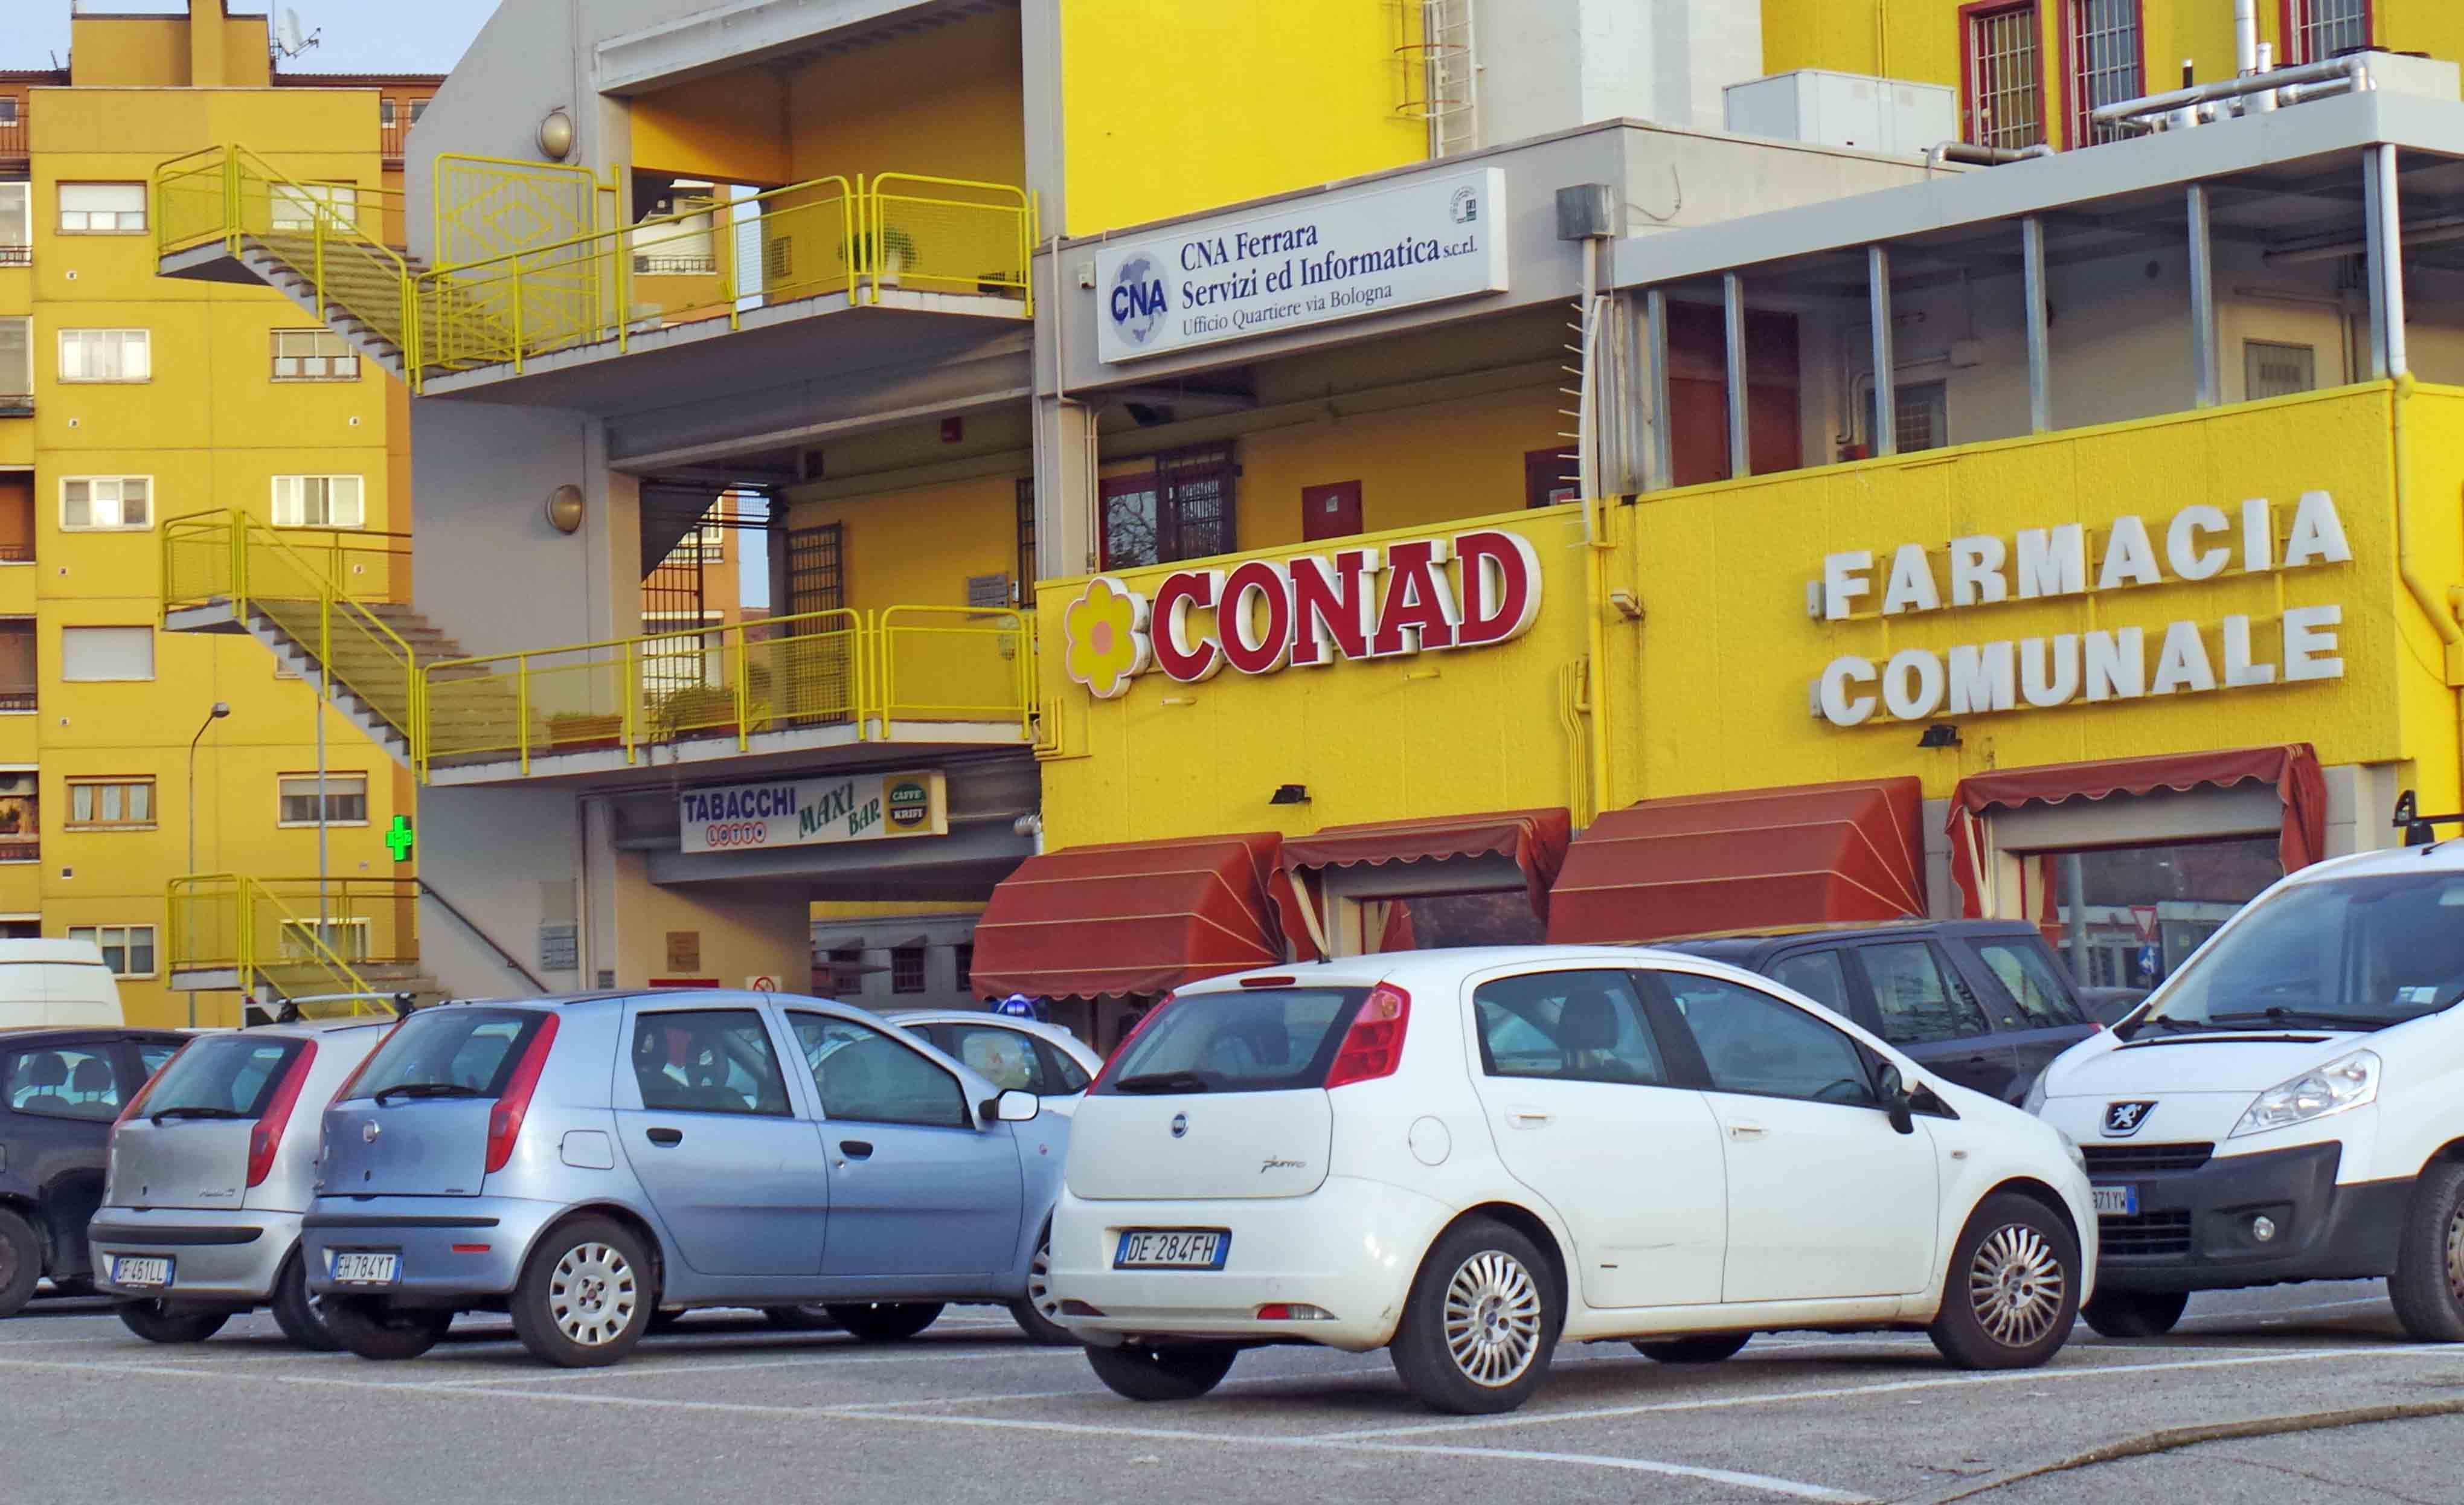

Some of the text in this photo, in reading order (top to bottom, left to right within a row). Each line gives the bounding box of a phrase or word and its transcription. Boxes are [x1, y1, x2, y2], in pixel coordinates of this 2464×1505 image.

[1181, 224, 1319, 271] CNA Ferrara
[1182, 268, 1258, 309] Servizi
[1265, 260, 1292, 293] ed
[1300, 236, 1440, 287] Informatica
[1111, 278, 1167, 322] CNA
[1182, 284, 1392, 336] Ufficio Quartiere via Bologna
[1824, 490, 2353, 620] FARMACIA
[1150, 530, 1542, 682] CONAD
[1820, 605, 2344, 727] COMUNALE
[684, 787, 796, 822] TABACCHI
[798, 780, 854, 840] MAXI
[849, 797, 881, 836] BAR
[707, 823, 765, 845] LOTTO
[353, 1256, 393, 1279] 784YT
[1127, 1235, 1217, 1262] DE 284FH
